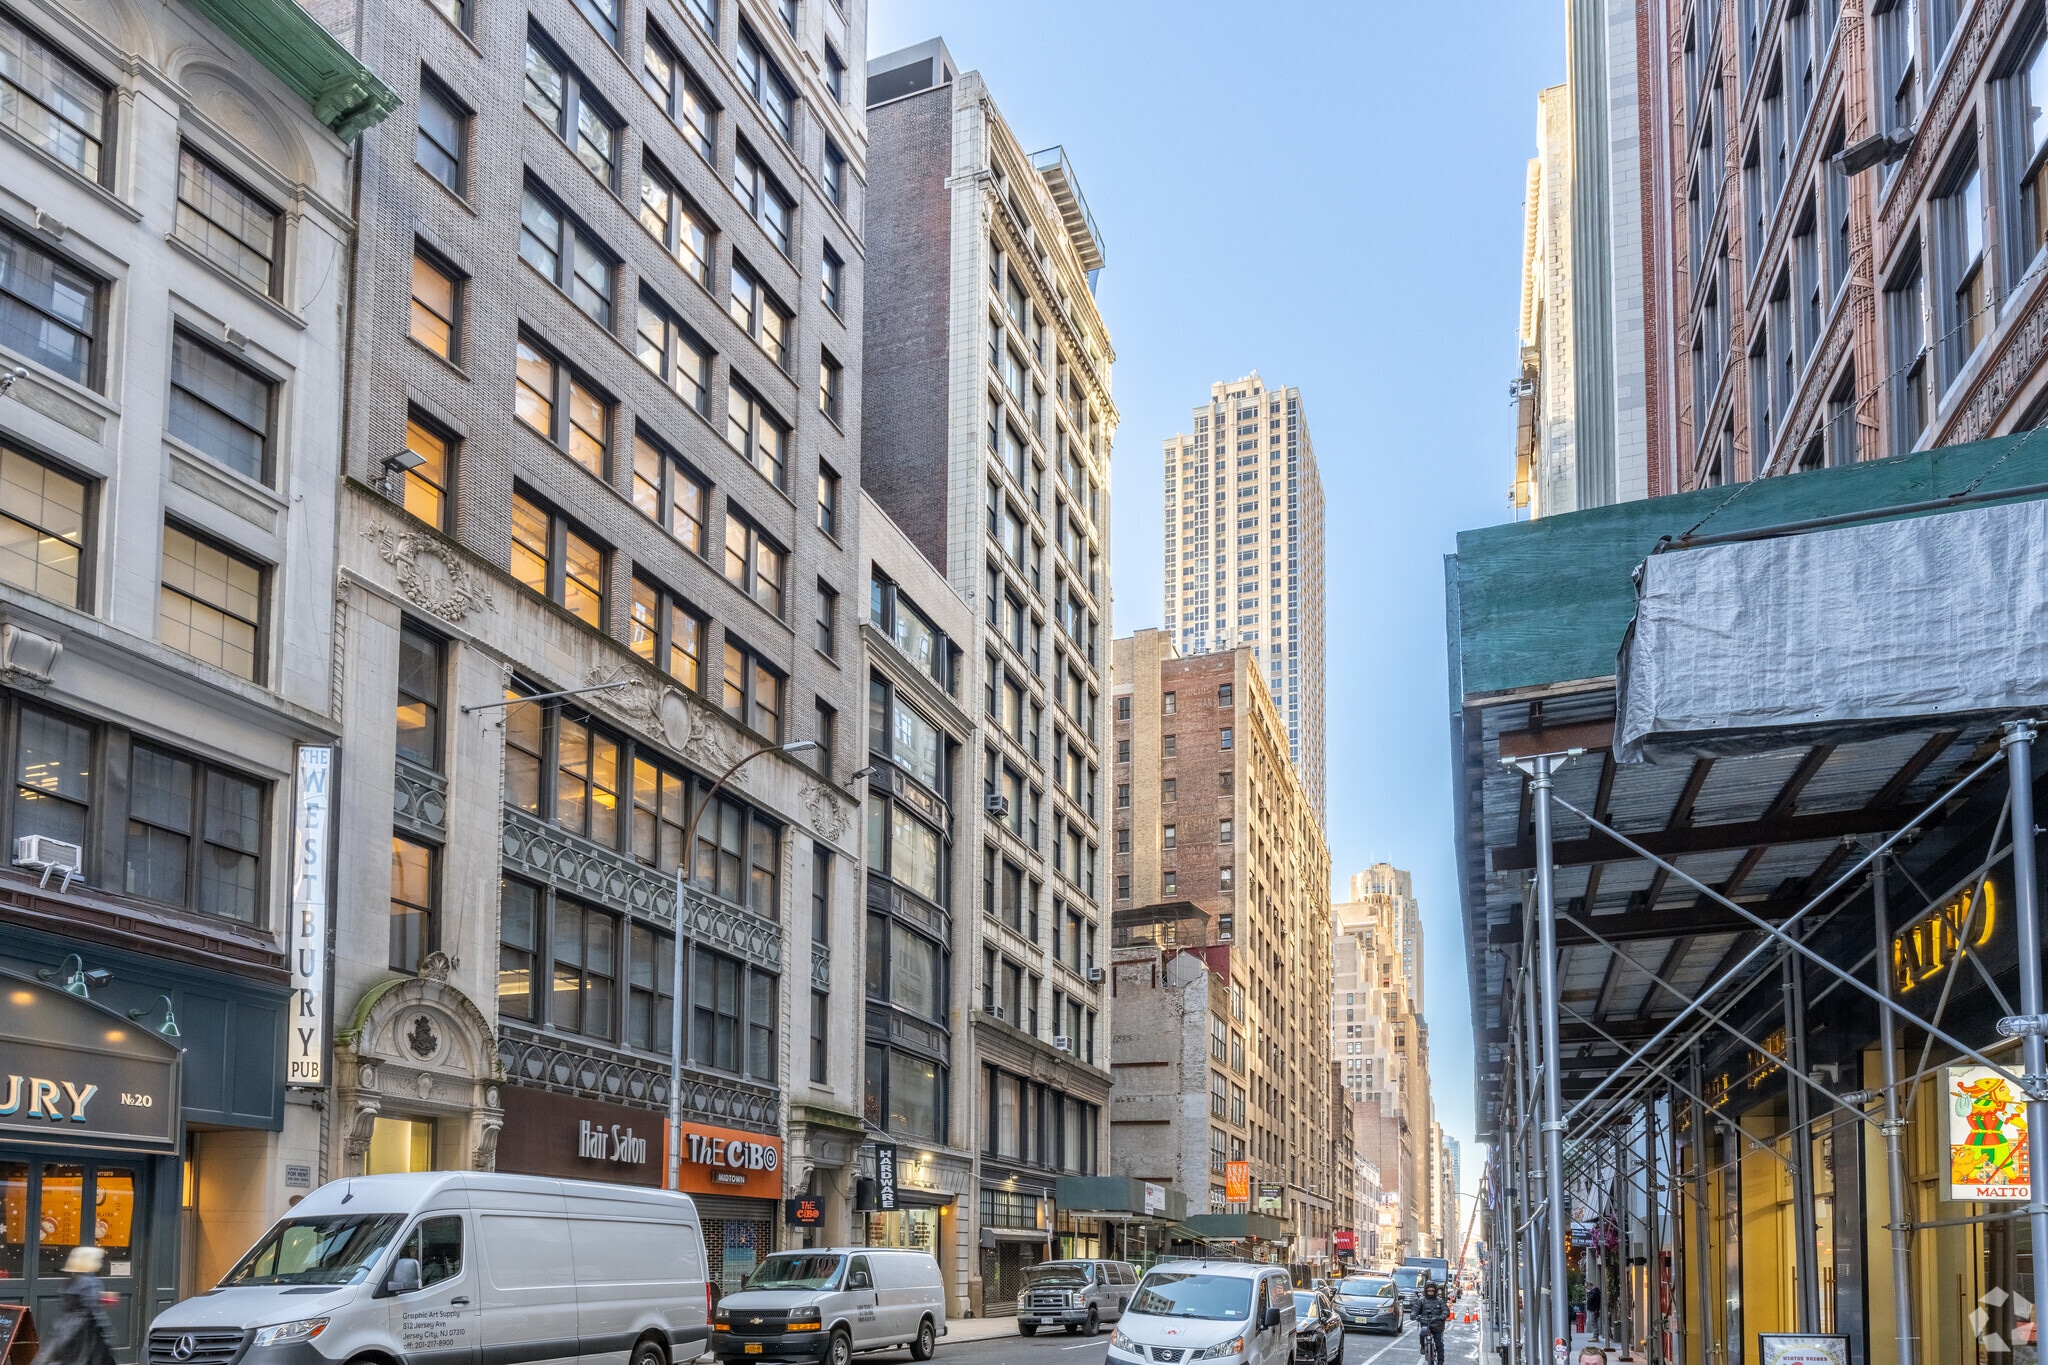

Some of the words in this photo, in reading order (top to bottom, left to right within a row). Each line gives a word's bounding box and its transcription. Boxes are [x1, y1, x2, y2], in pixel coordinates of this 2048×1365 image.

[301, 748, 328, 764] THE
[298, 768, 327, 1056] WESTBURY
[291, 1061, 319, 1078] PUB
[578, 1119, 609, 1160] Hair
[609, 1124, 647, 1164] Salon
[718, 1173, 745, 1184] MIDTOWN
[879, 1150, 895, 1208] HARDWARE
[1976, 1187, 2029, 1197] MATTO
[402, 1312, 428, 1320] Graphic
[439, 1310, 460, 1318] Supply
[402, 1322, 414, 1330] 812
[414, 1321, 435, 1329] Jersey
[435, 1320, 447, 1328] Ave
[402, 1332, 424, 1341] Jersey
[424, 1330, 440, 1340] City,
[440, 1329, 449, 1337] NJ
[448, 1328, 466, 1336] 07310
[403, 1341, 414, 1350] off:
[414, 1339, 454, 1349] 201-217-8900
